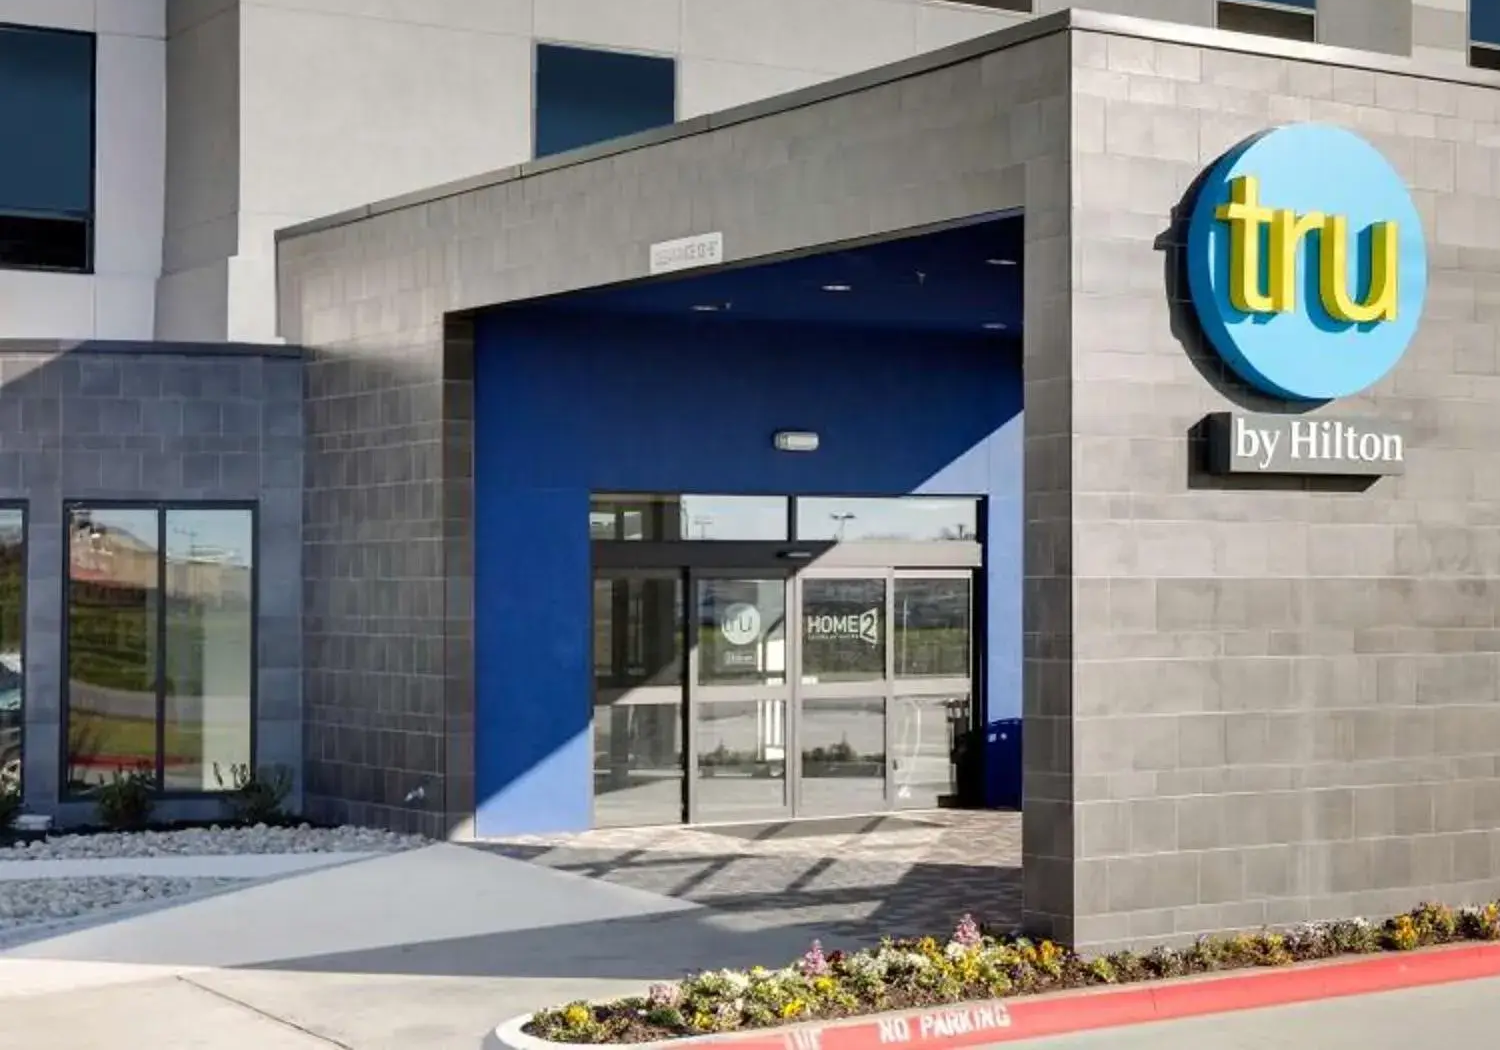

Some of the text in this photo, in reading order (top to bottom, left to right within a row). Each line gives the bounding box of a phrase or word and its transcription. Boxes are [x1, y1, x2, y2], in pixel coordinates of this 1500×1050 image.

[1214, 174, 1400, 324] tru
[1236, 417, 1403, 469] by Hilton
[877, 1004, 1012, 1044] NO PARKING
